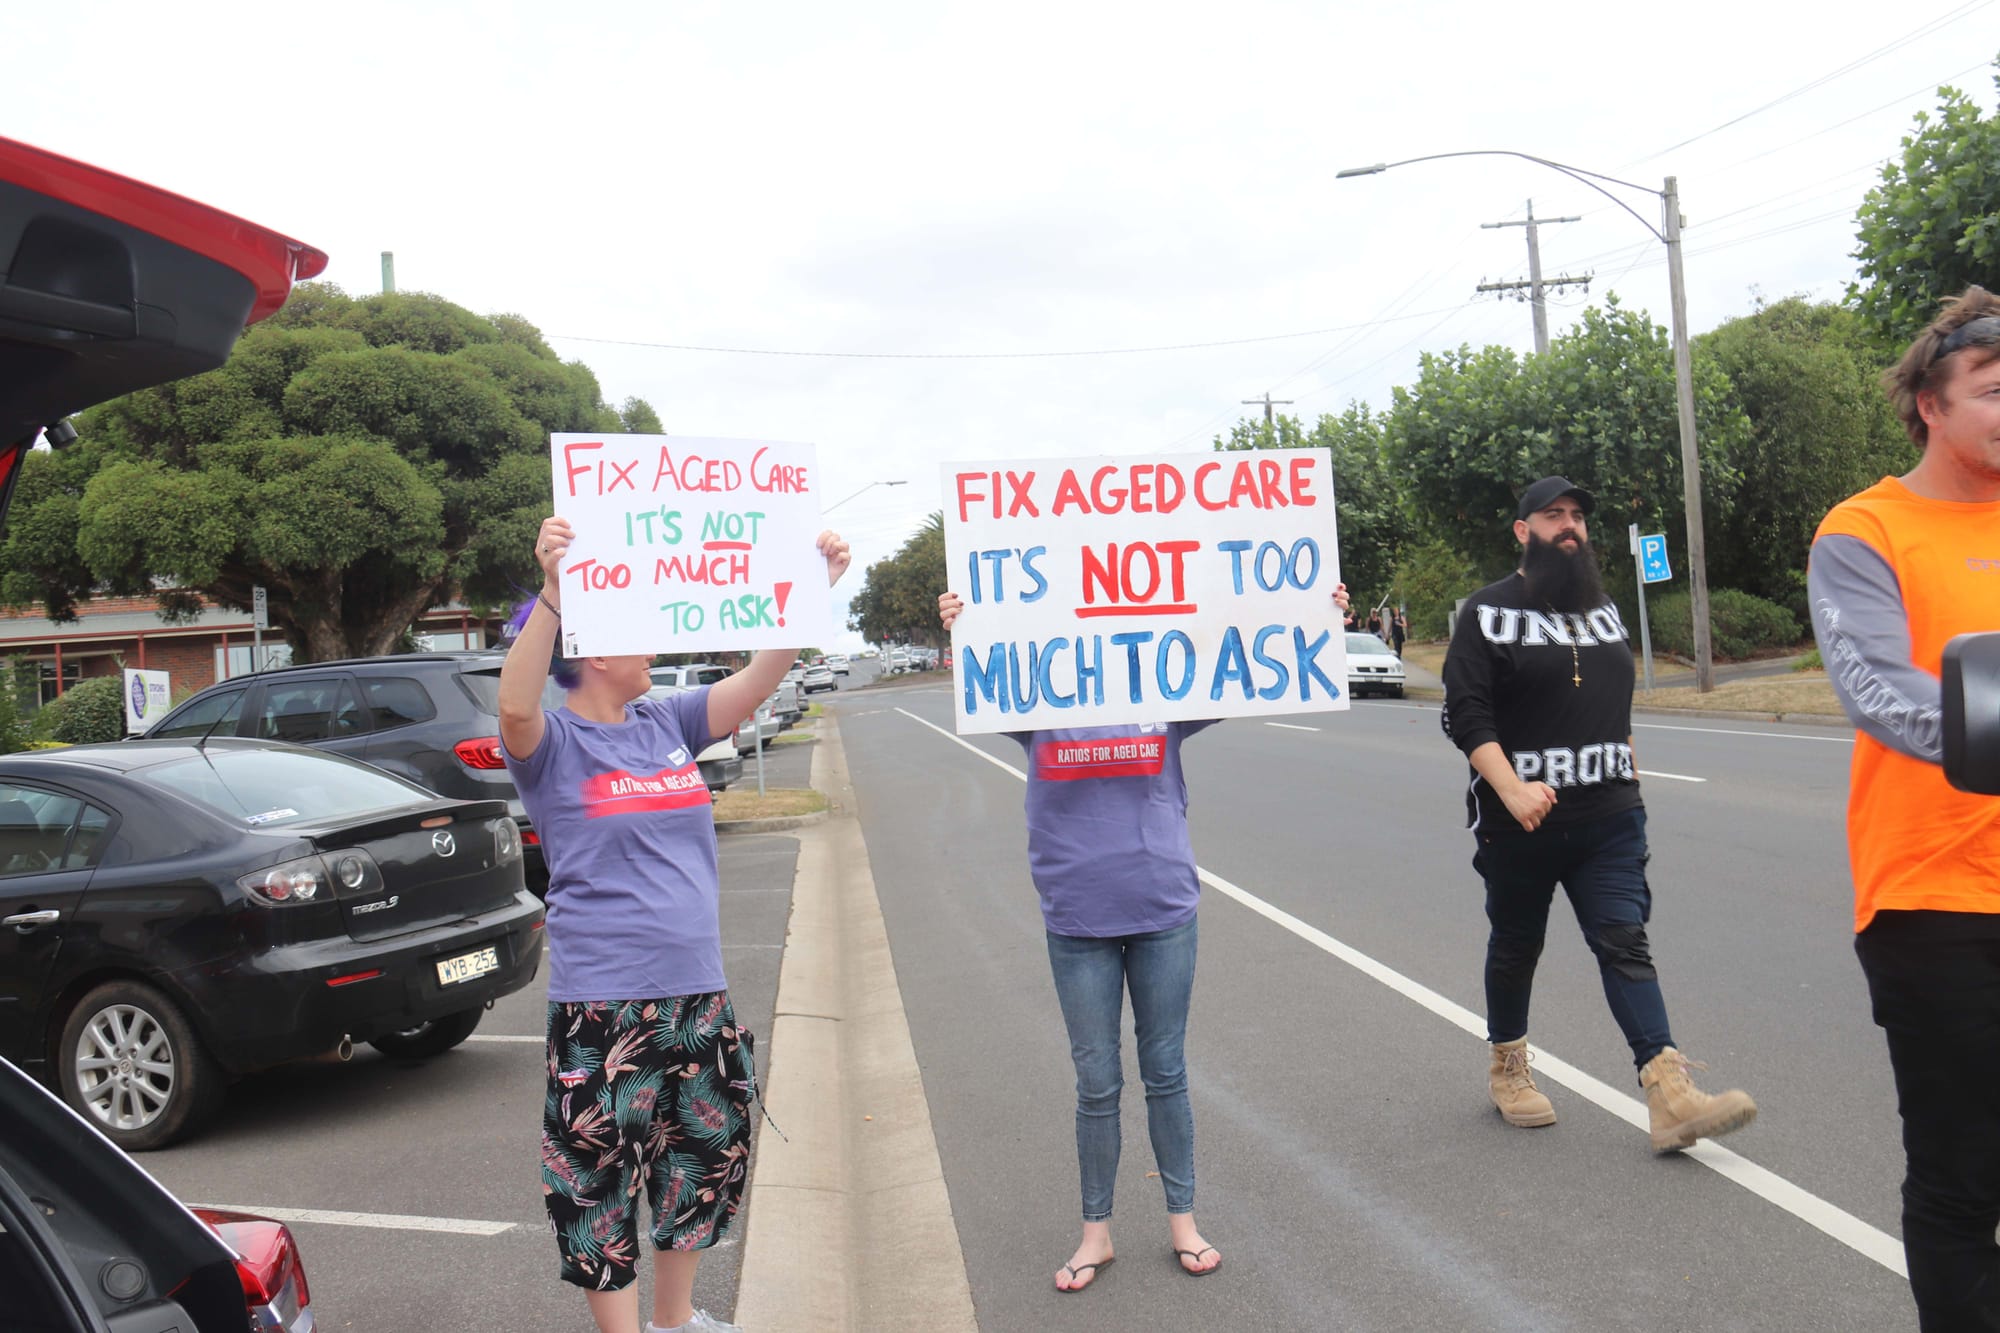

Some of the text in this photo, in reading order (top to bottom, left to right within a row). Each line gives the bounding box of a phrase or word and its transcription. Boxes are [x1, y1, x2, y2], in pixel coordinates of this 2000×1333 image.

[564, 442, 809, 496] FIX AGED CARE
[956, 458, 1317, 522] FIX AGED CARE
[625, 504, 766, 546] IT'S NOT
[1645, 540, 1660, 558] P
[566, 554, 750, 591] TOO MUCH
[968, 536, 1321, 605] IT'S NOT TOO
[660, 581, 793, 634] TO ASK!
[962, 624, 1341, 715] MUCH TO ASK
[1058, 743, 1160, 763] RATIOS FOR AGED CARE
